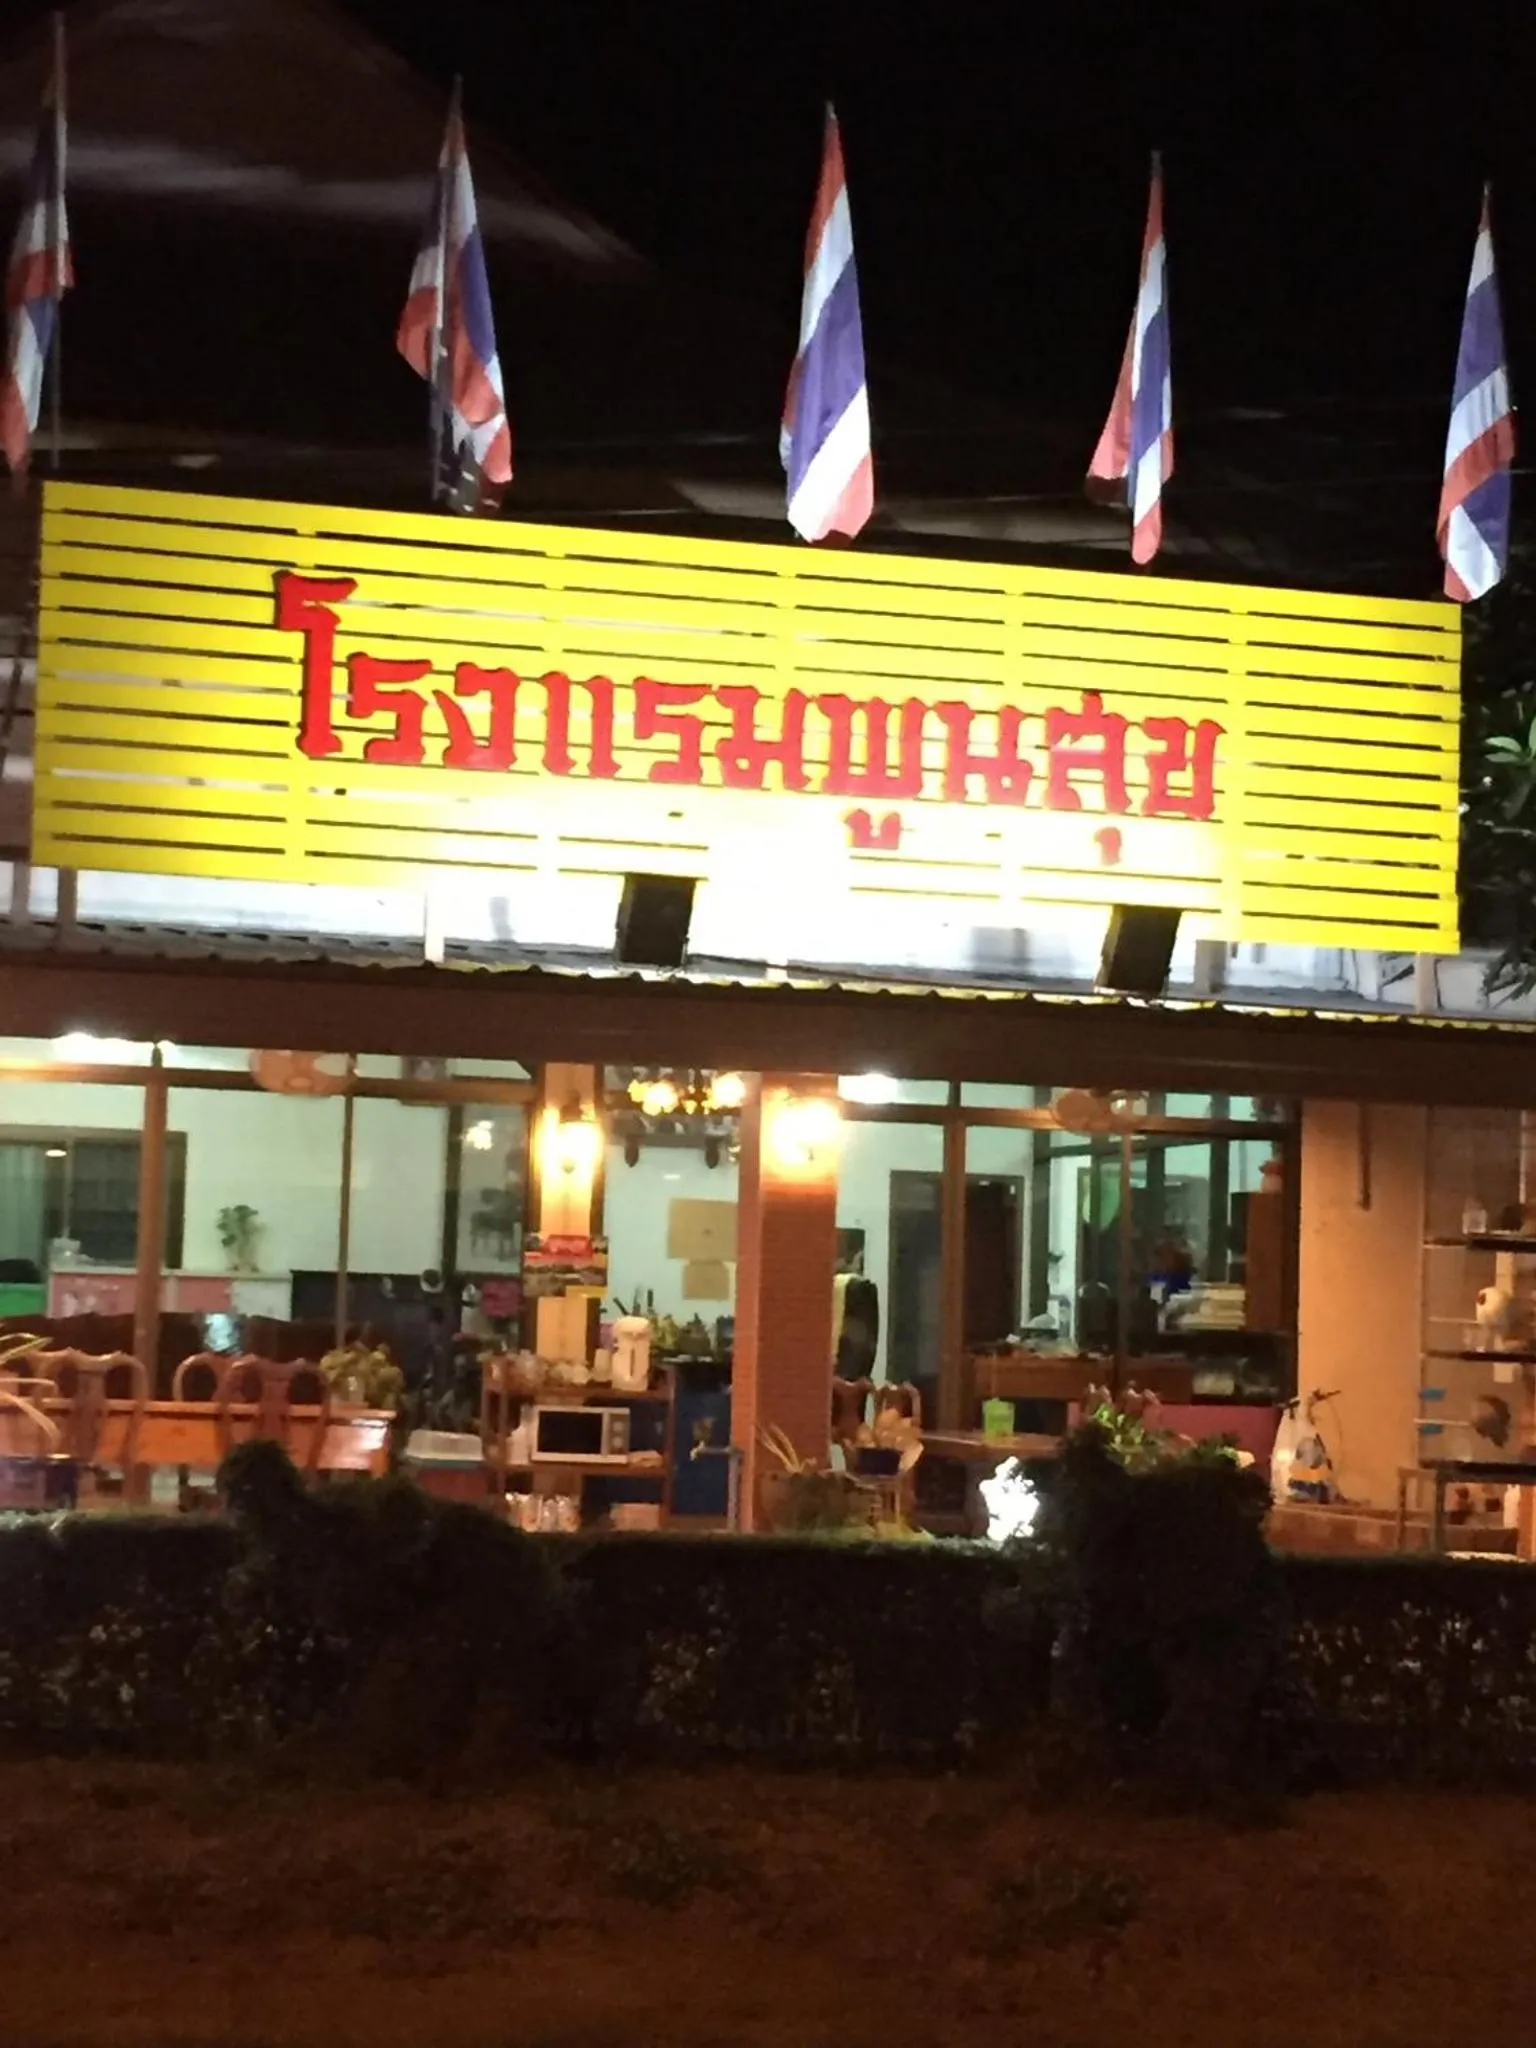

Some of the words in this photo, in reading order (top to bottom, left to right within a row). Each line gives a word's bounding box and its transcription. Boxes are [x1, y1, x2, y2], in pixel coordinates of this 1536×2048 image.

[273, 568, 1227, 865] โรงแรมพูนสุข
